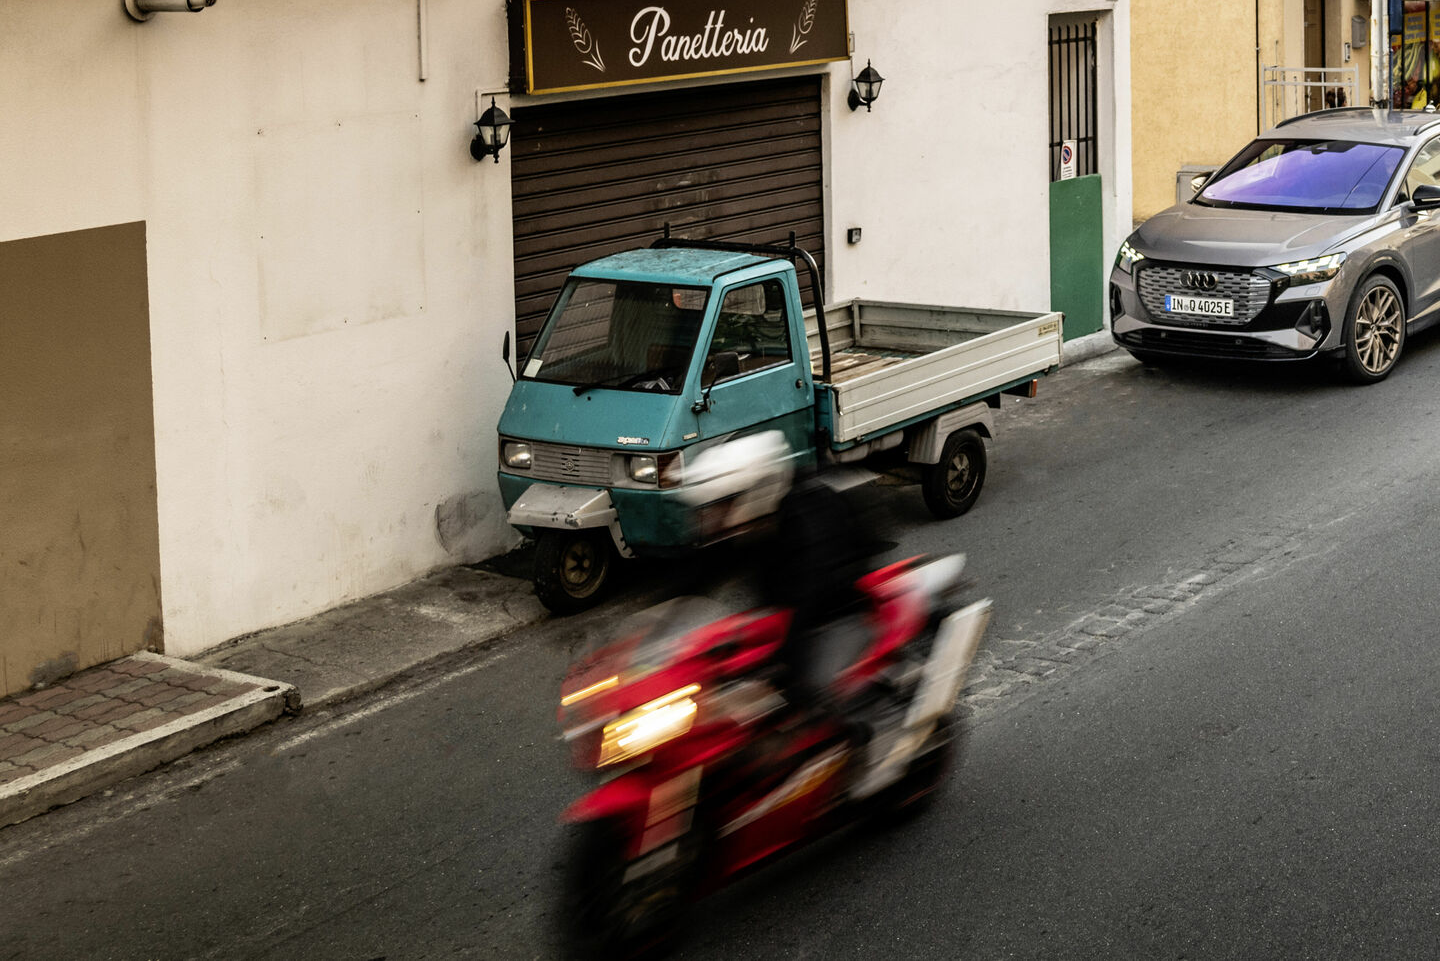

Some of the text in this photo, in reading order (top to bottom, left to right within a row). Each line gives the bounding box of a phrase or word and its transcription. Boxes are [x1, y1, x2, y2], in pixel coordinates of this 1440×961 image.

[628, 6, 769, 67] Panetteria
[1172, 298, 1183, 311] IN
[1189, 299, 1196, 312] Q
